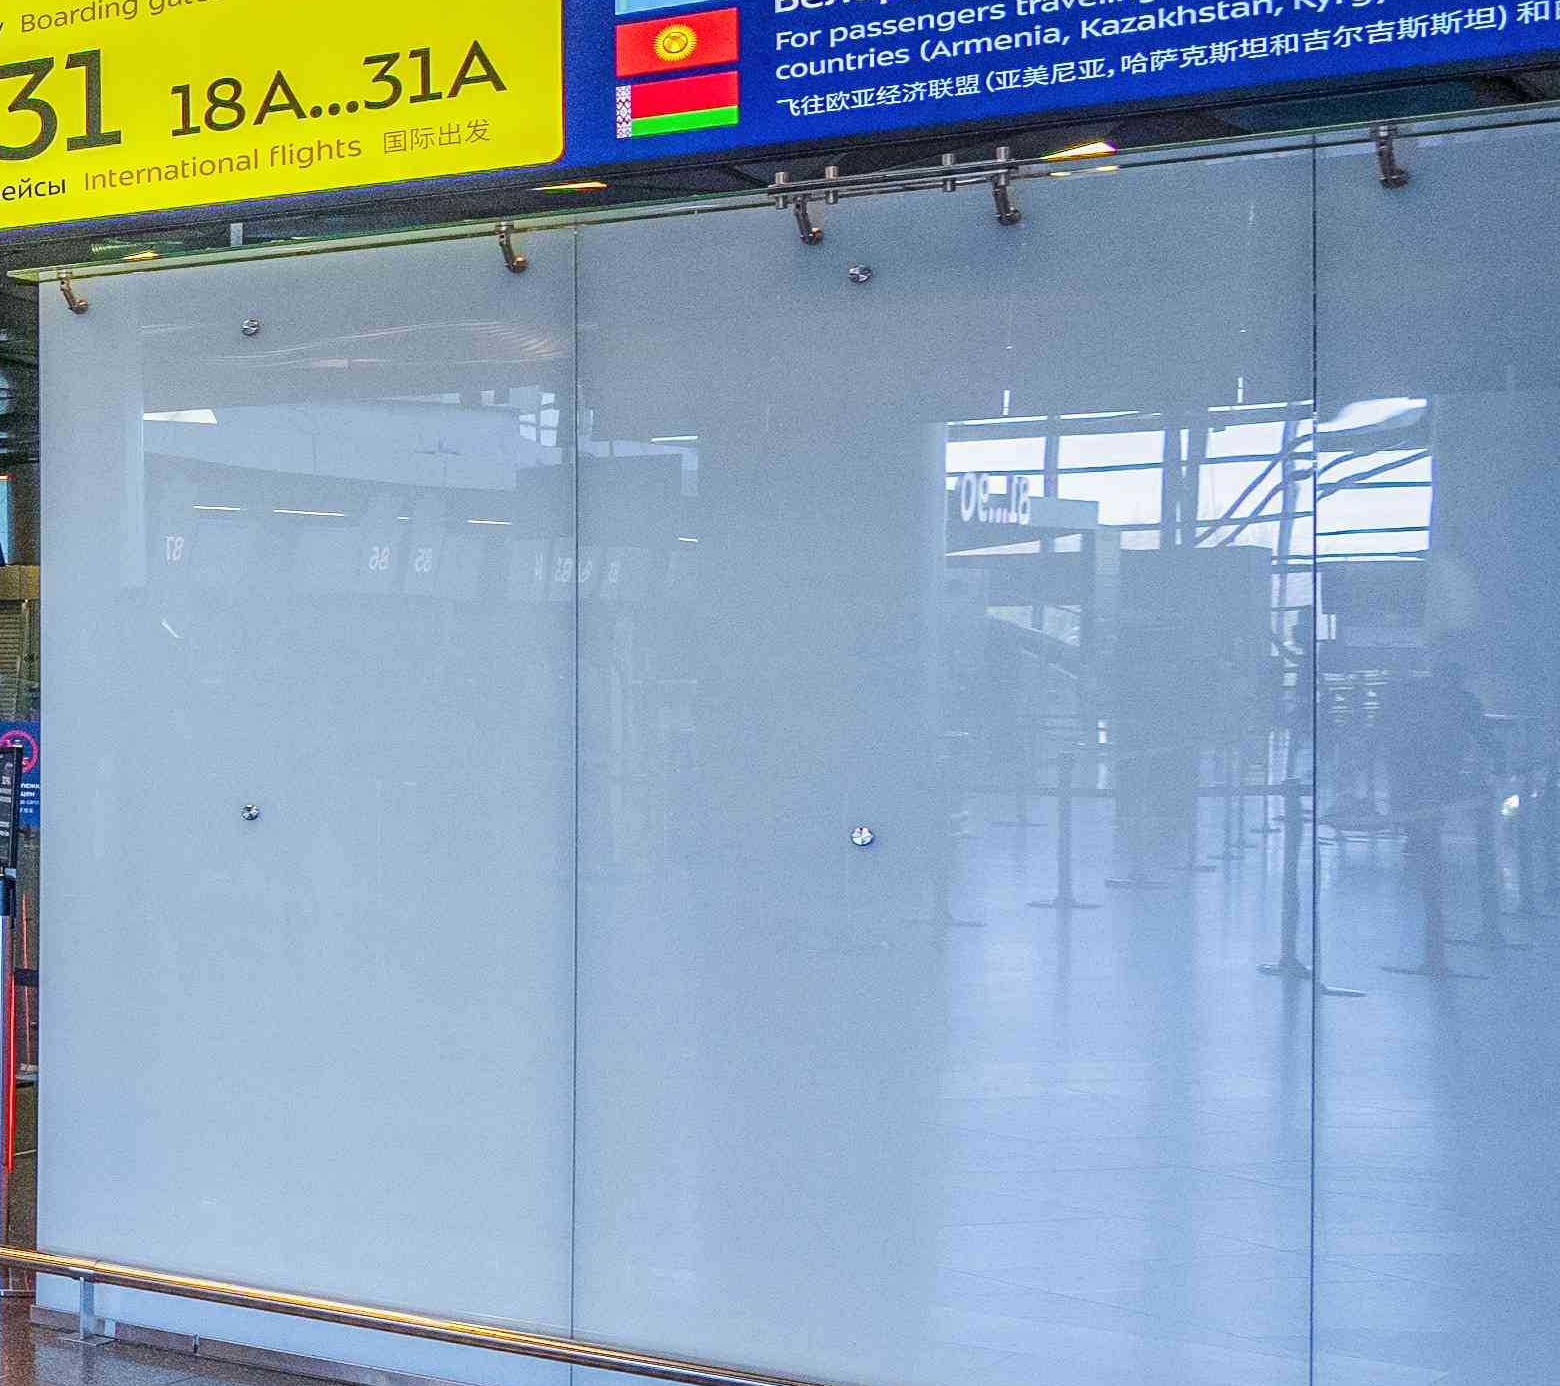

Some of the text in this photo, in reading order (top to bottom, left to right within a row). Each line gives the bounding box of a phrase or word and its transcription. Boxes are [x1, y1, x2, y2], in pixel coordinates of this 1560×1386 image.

[776, 28, 823, 51] For
[829, 0, 1006, 48] passengers
[776, 47, 910, 80] countries
[920, 24, 1071, 62] (Armenia,
[776, 74, 980, 117] 飞往欧亚经济联盟
[83, 149, 260, 193] International
[267, 133, 362, 173] flights
[382, 118, 492, 156] 国际出发
